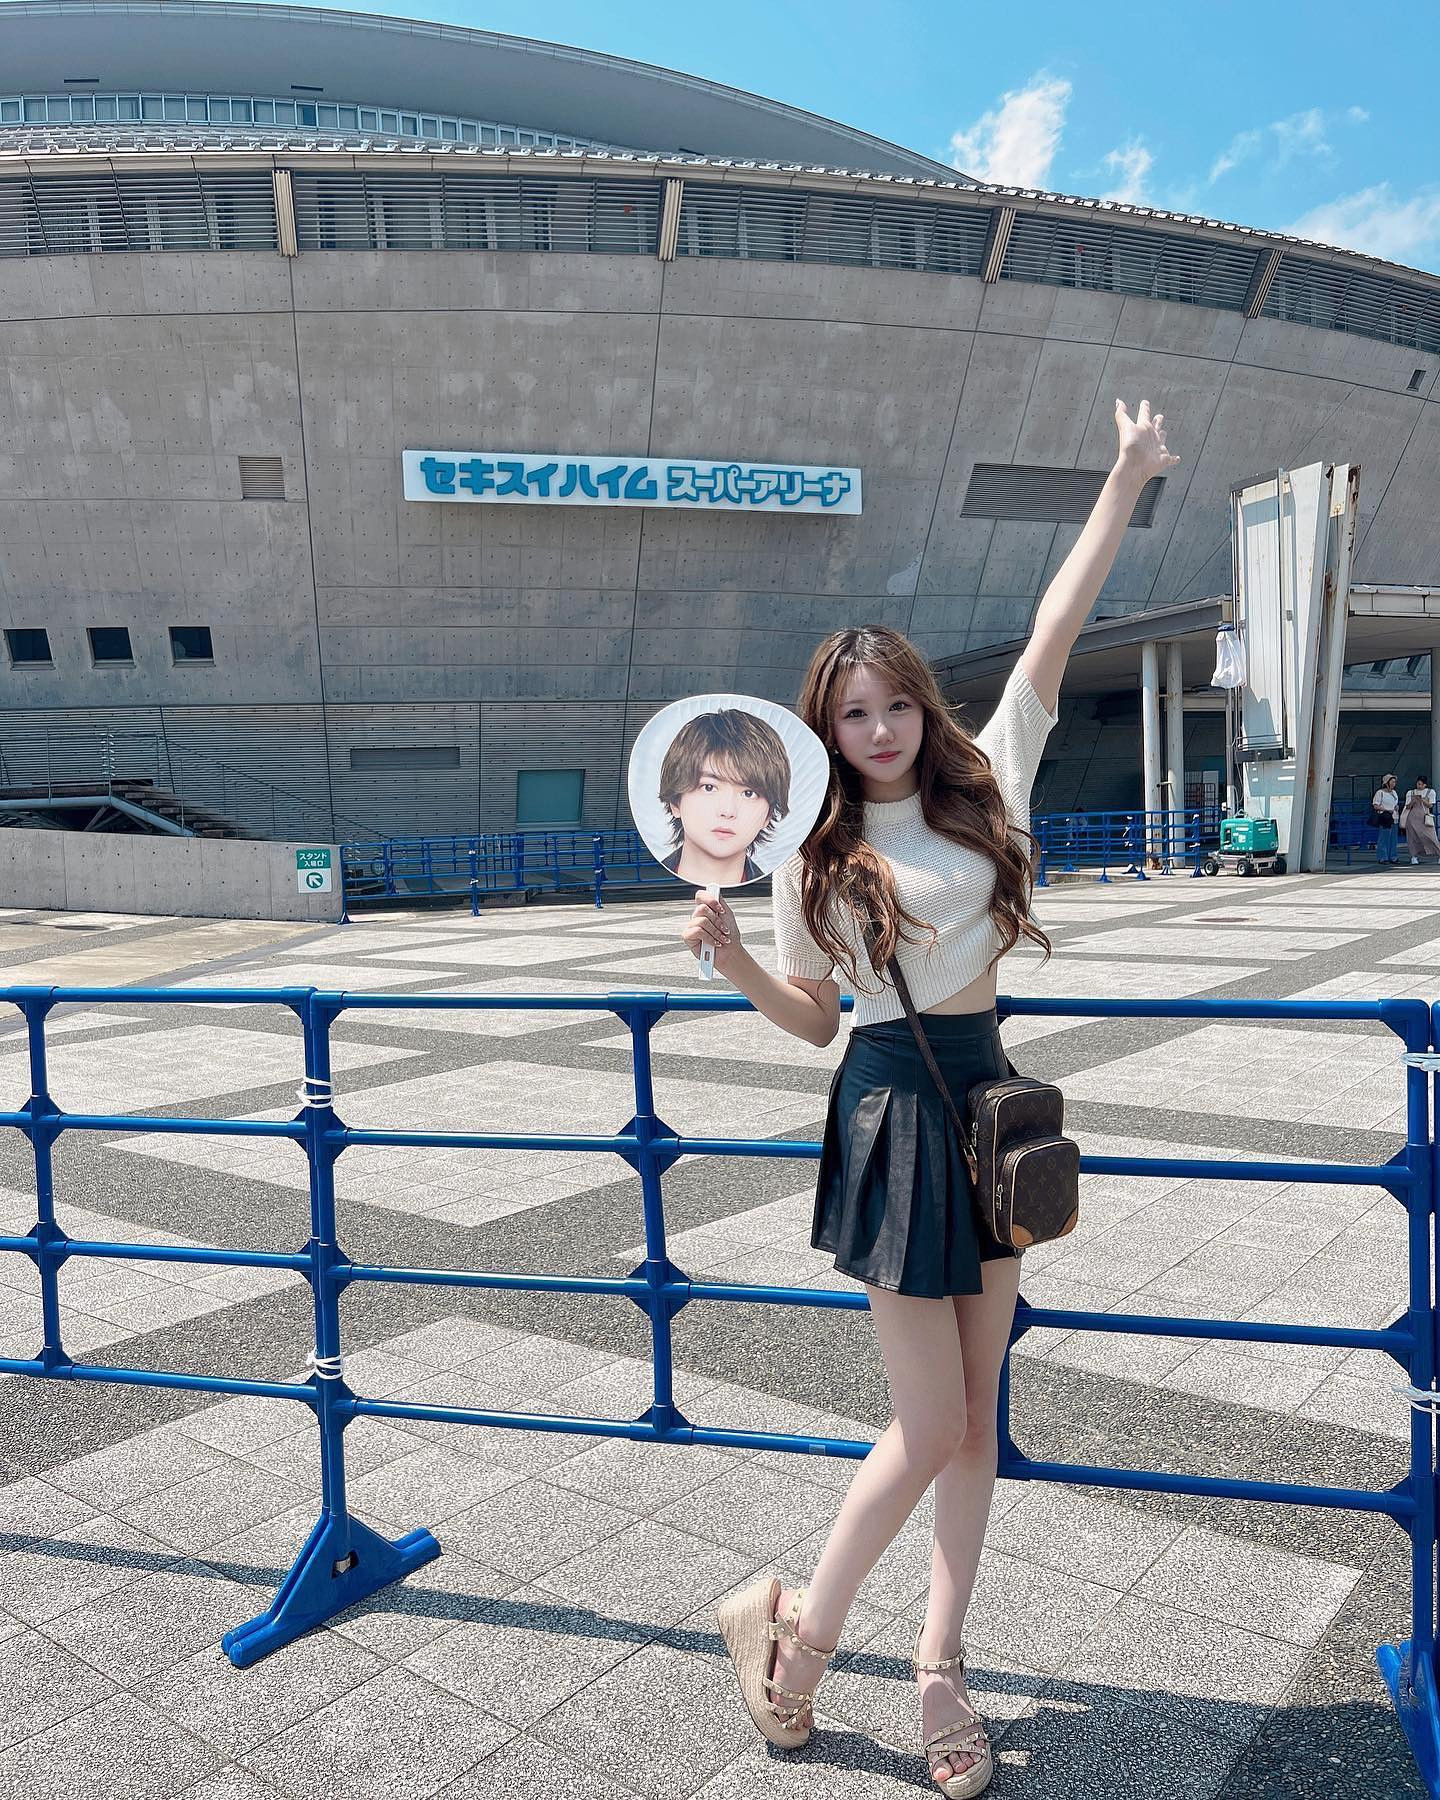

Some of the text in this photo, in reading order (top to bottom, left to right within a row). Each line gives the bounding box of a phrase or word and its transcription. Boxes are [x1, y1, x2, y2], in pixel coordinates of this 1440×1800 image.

[420, 457, 851, 507] セキスイハイム スーパーアリーナ
[299, 852, 327, 860] スタンド
